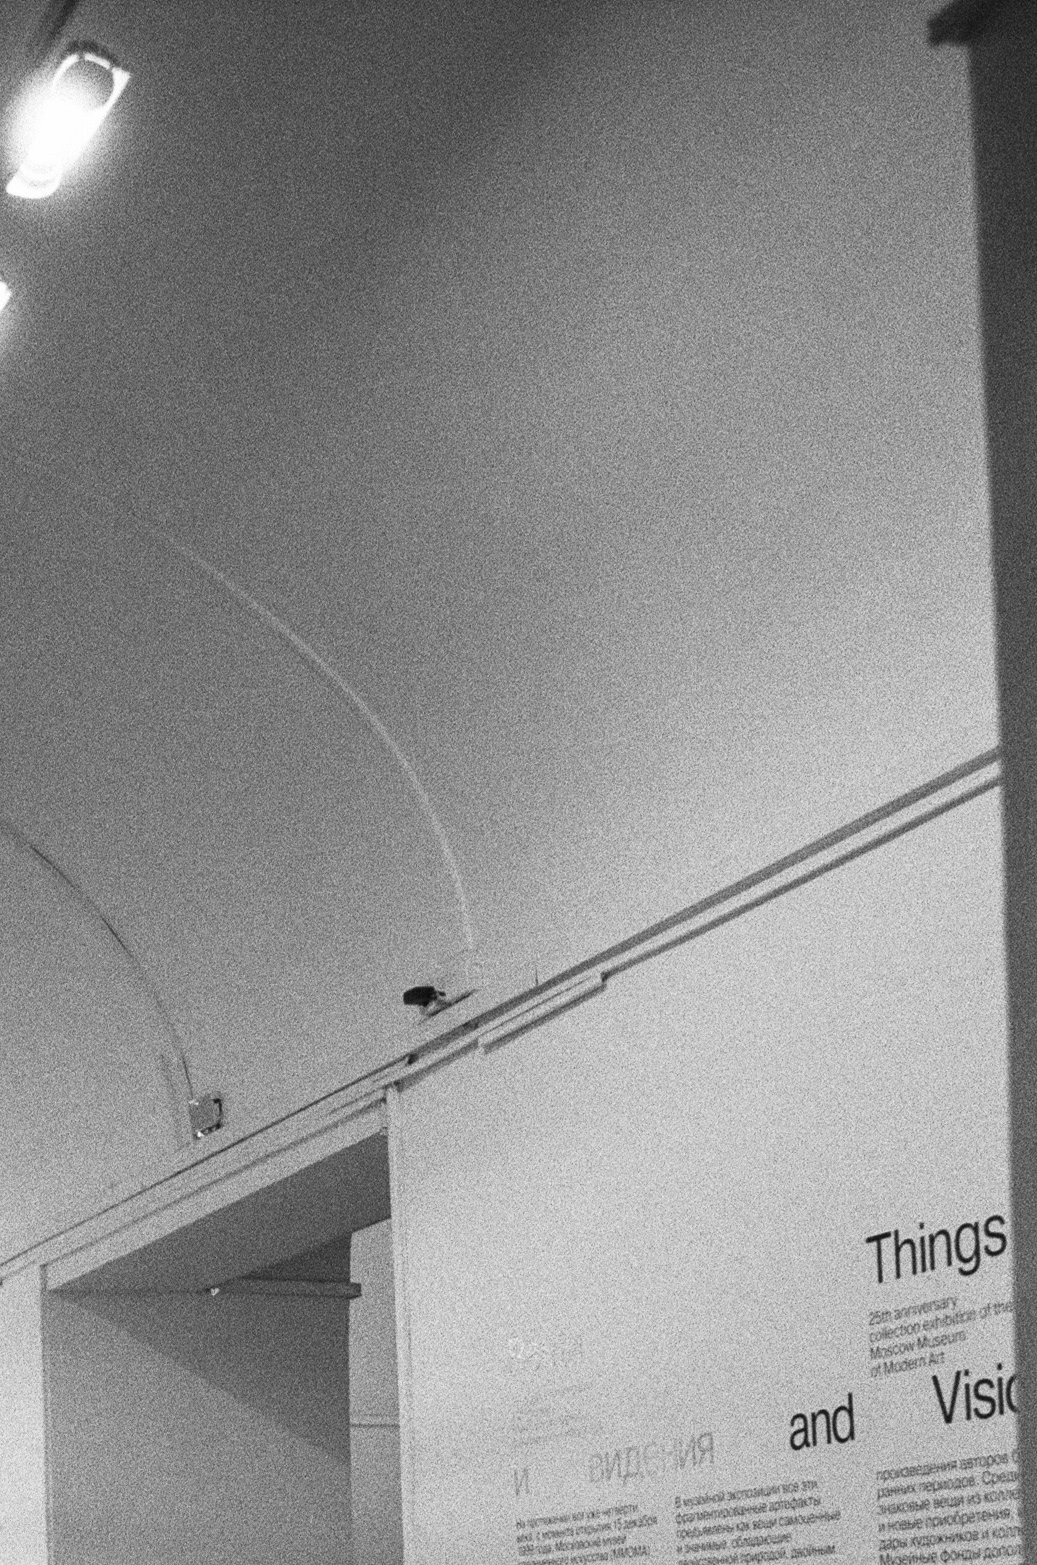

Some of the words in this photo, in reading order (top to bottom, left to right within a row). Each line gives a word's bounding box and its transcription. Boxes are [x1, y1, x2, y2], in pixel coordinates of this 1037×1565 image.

[865, 1214, 1007, 1283] Things
[869, 1319, 920, 1342] collection
[922, 1307, 975, 1331] exhibition
[870, 1339, 913, 1359] Moscow
[917, 1328, 966, 1350] Museum
[883, 1354, 925, 1374] Modern
[928, 1351, 944, 1365] Art
[789, 1393, 855, 1451] and
